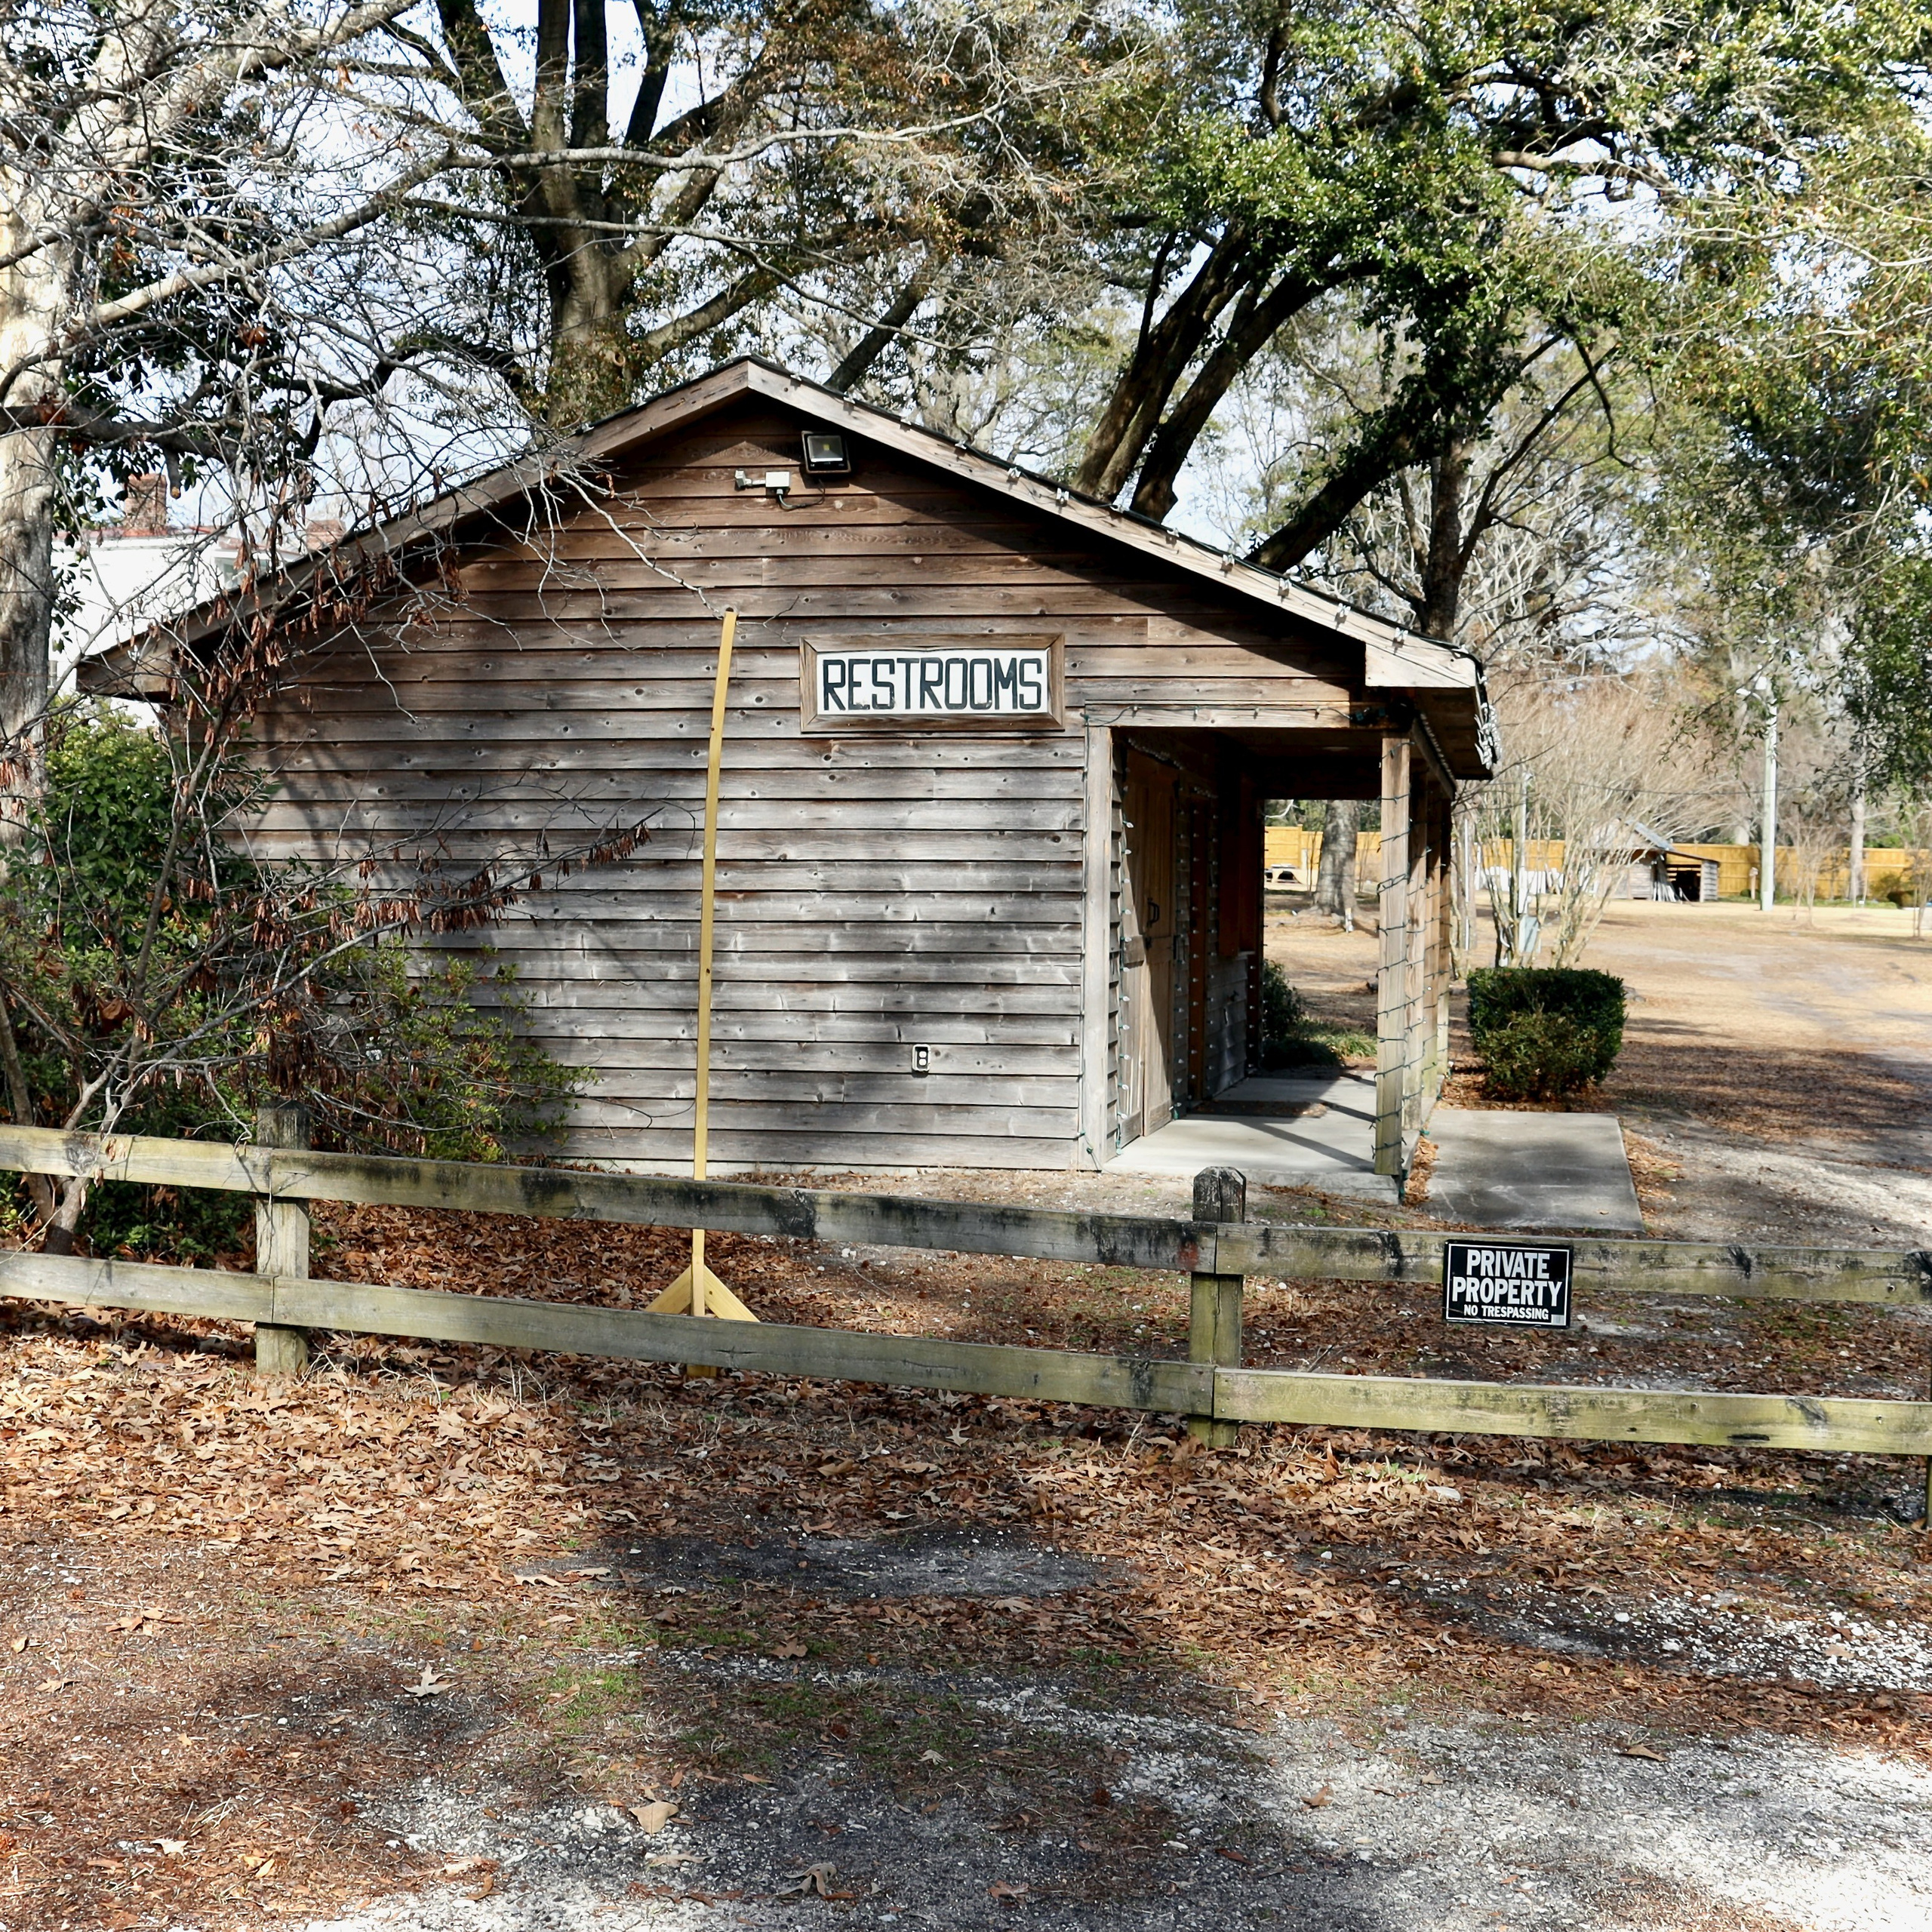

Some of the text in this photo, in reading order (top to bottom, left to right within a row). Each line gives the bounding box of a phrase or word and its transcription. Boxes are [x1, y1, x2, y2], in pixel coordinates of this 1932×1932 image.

[823, 657, 1042, 710] RESTROOMS
[1466, 1249, 1550, 1279] PRIVATE
[1452, 1276, 1562, 1306] PROPERTY
[1463, 1304, 1549, 1320] NO TRESPASSING
